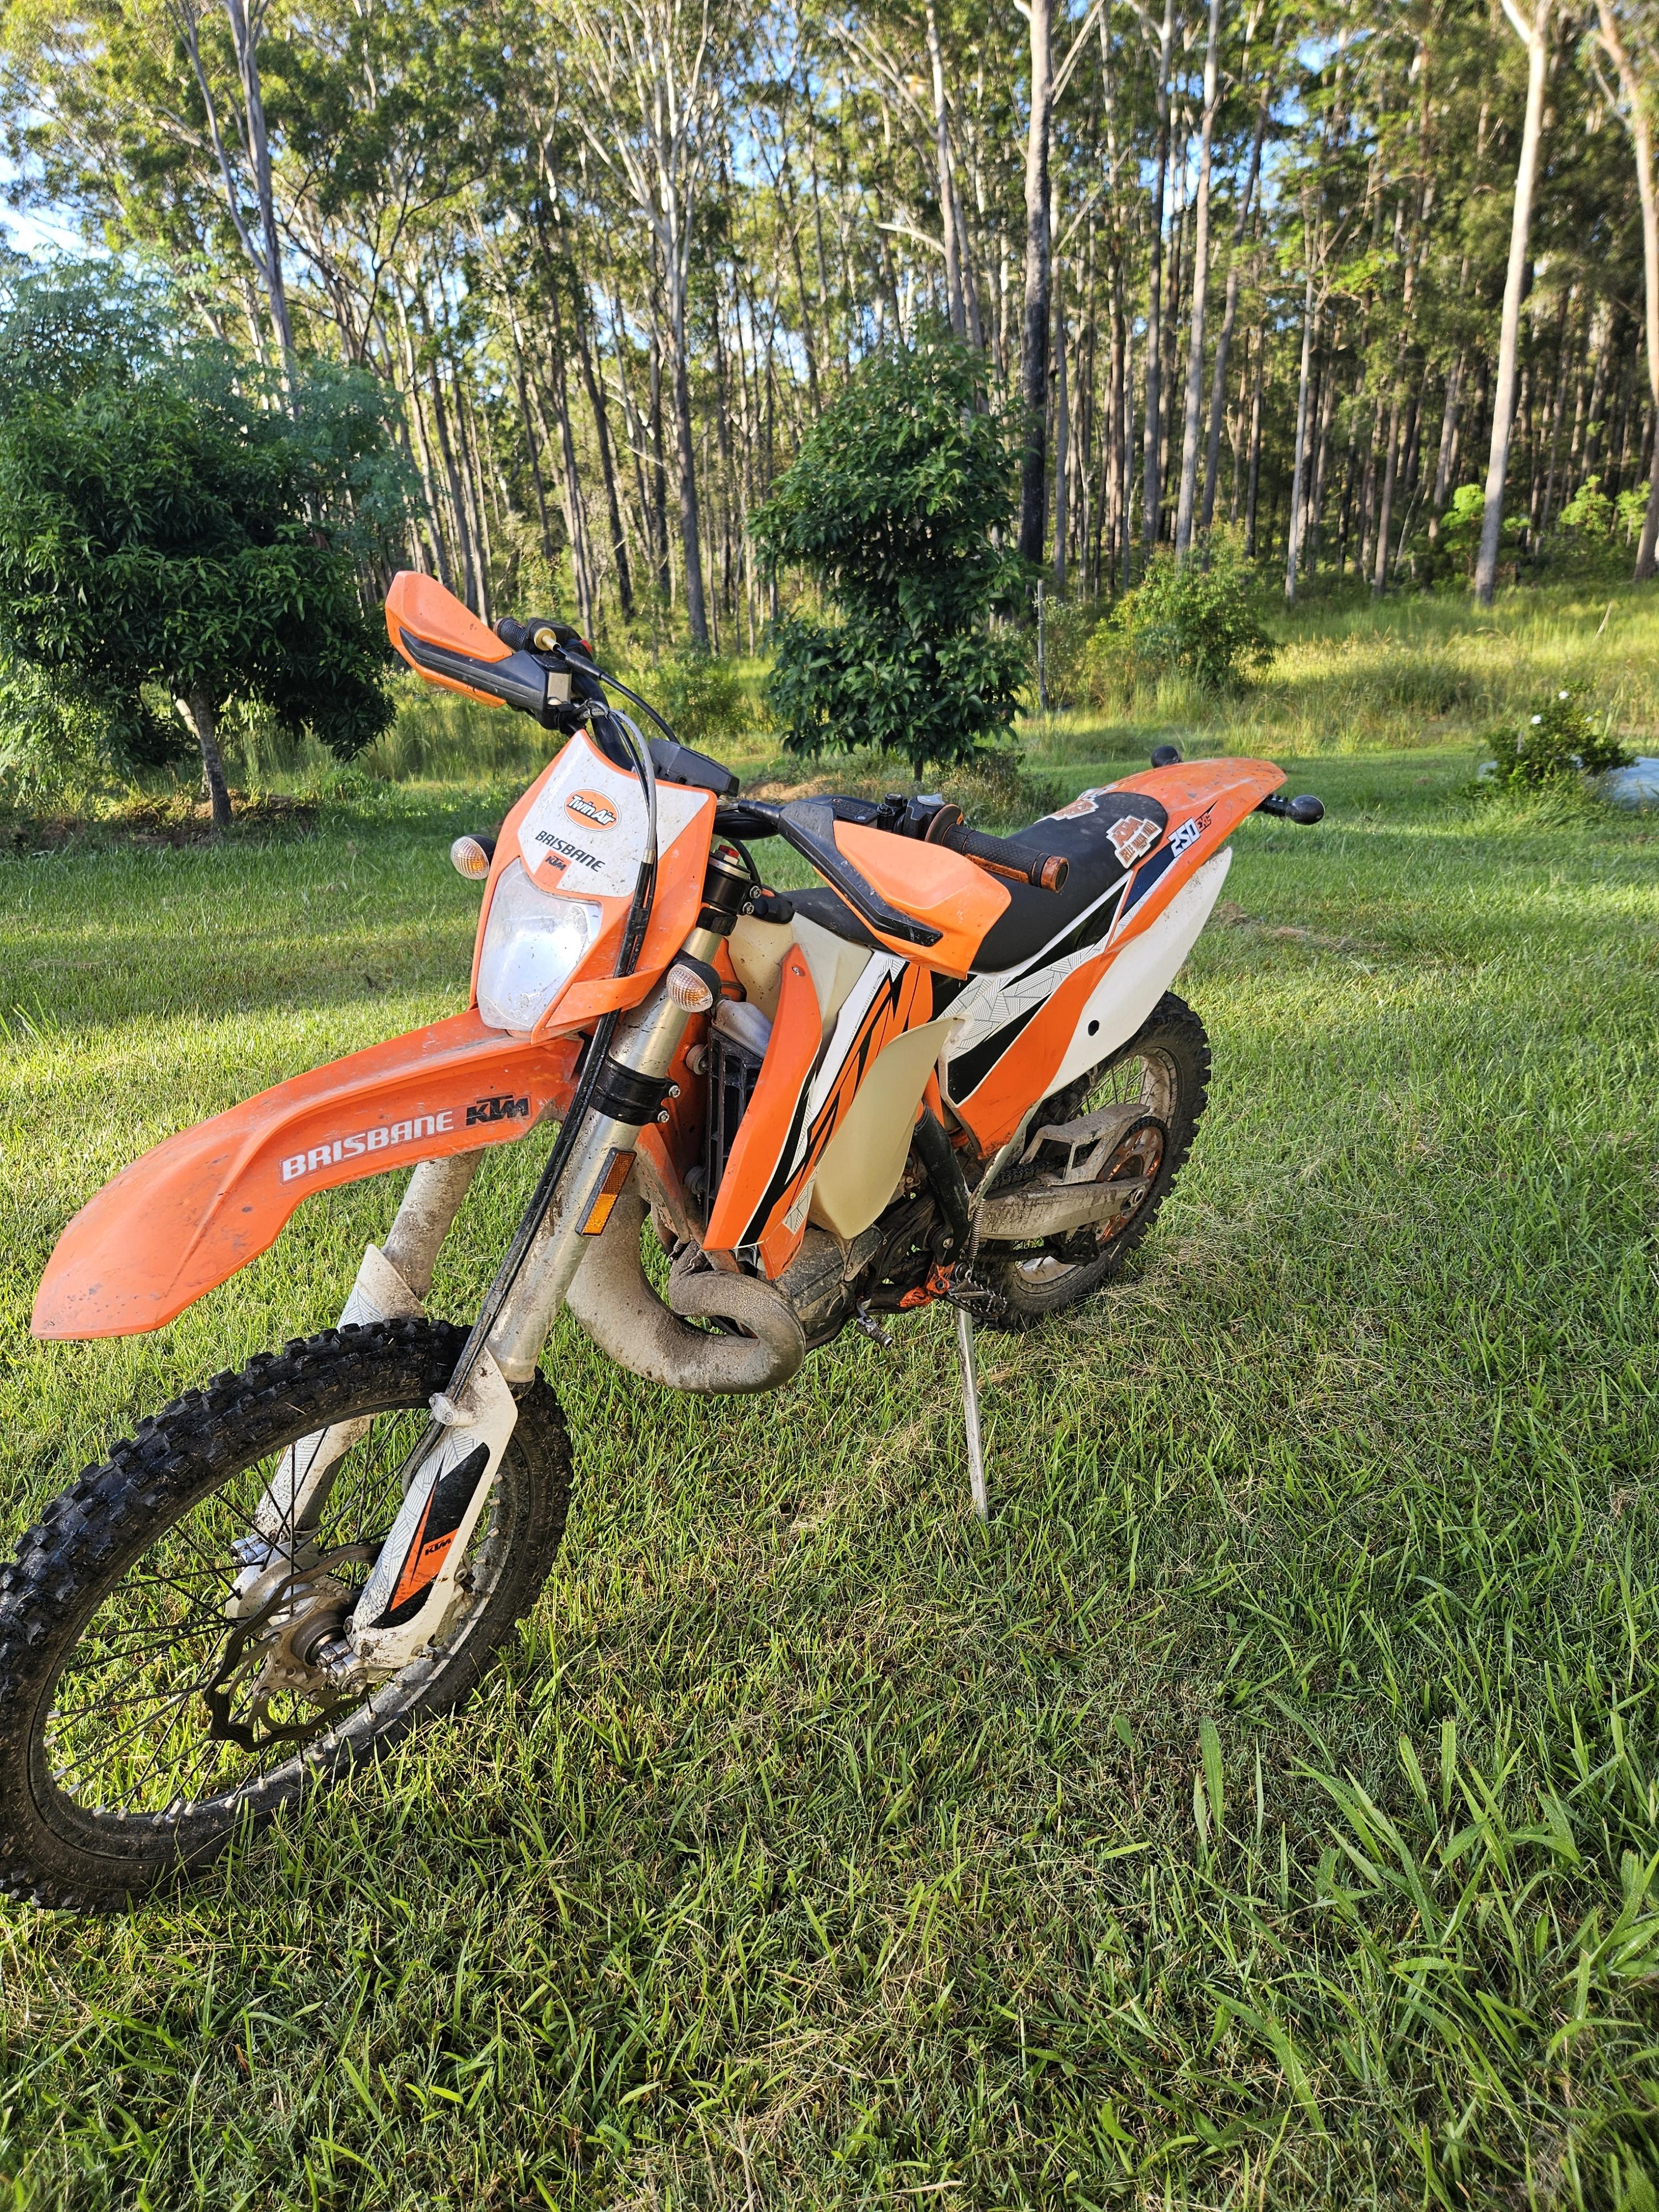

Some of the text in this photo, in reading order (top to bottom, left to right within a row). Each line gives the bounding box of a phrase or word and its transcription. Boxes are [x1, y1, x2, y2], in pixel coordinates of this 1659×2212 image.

[567, 795, 616, 826] Twin Air
[535, 831, 606, 872] BRISBANE
[1168, 817, 1201, 857] 250
[545, 855, 567, 871] KTM
[283, 1094, 529, 1182] BRISBANE KTM
[425, 1538, 451, 1556] KTM
